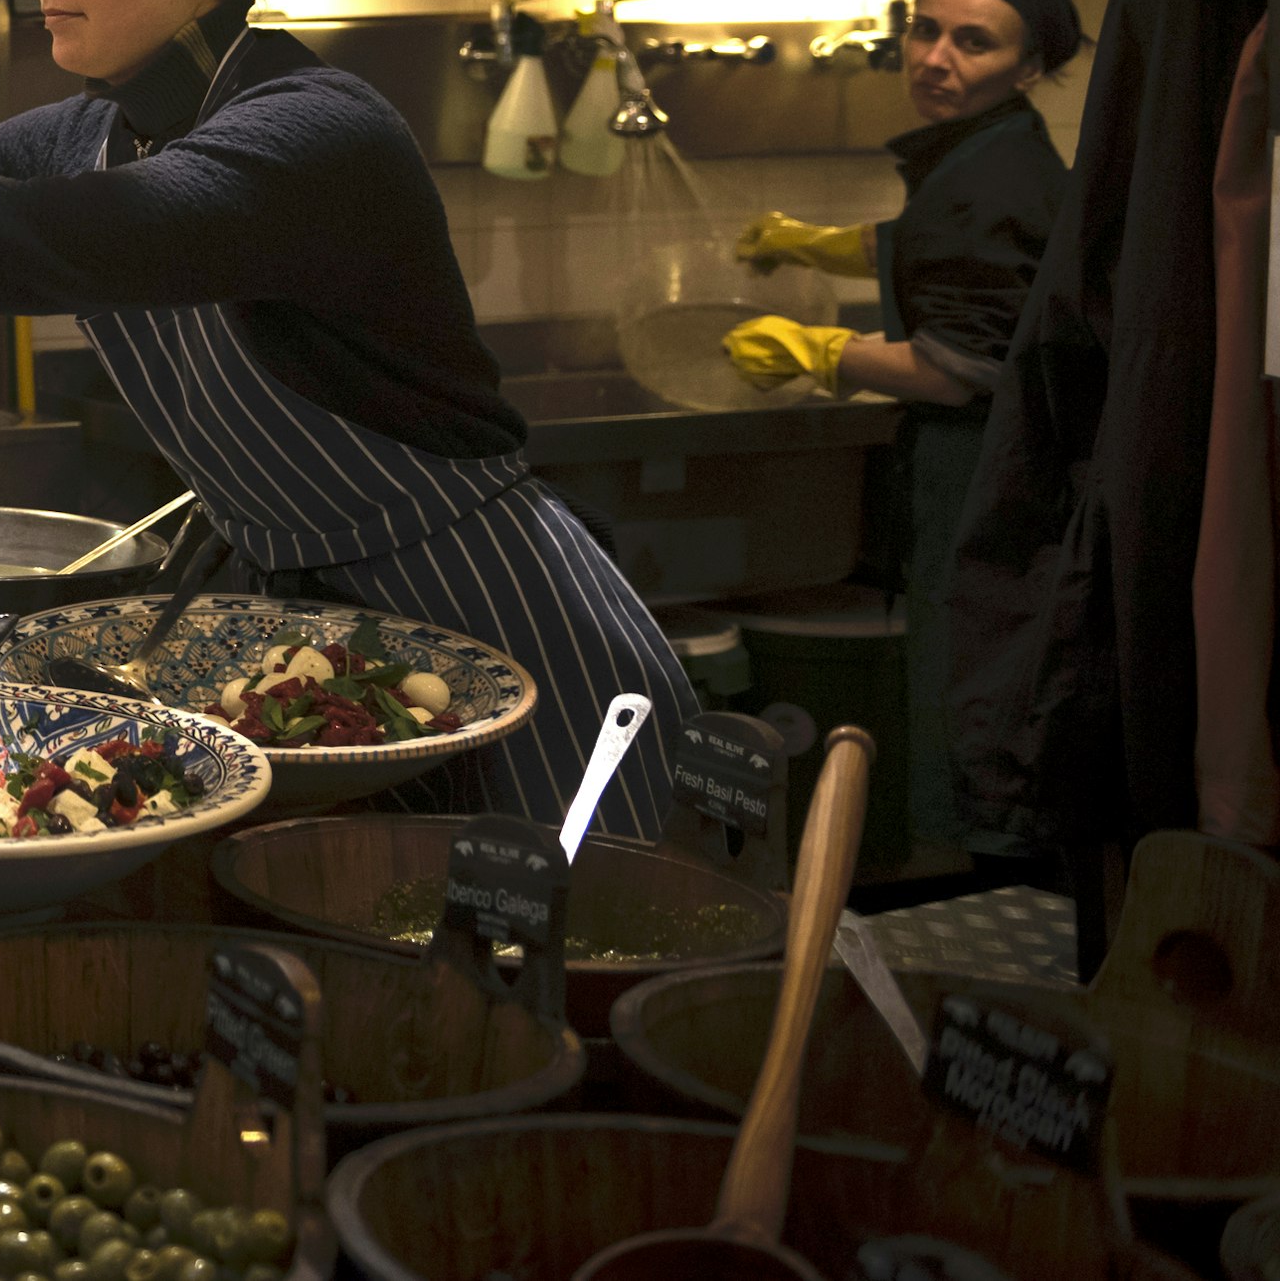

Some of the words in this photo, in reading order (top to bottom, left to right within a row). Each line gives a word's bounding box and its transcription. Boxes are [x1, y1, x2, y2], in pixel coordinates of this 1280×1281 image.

[674, 764, 704, 791] Fresh
[706, 778, 733, 802] Basil
[734, 789, 767, 818] Pesto
